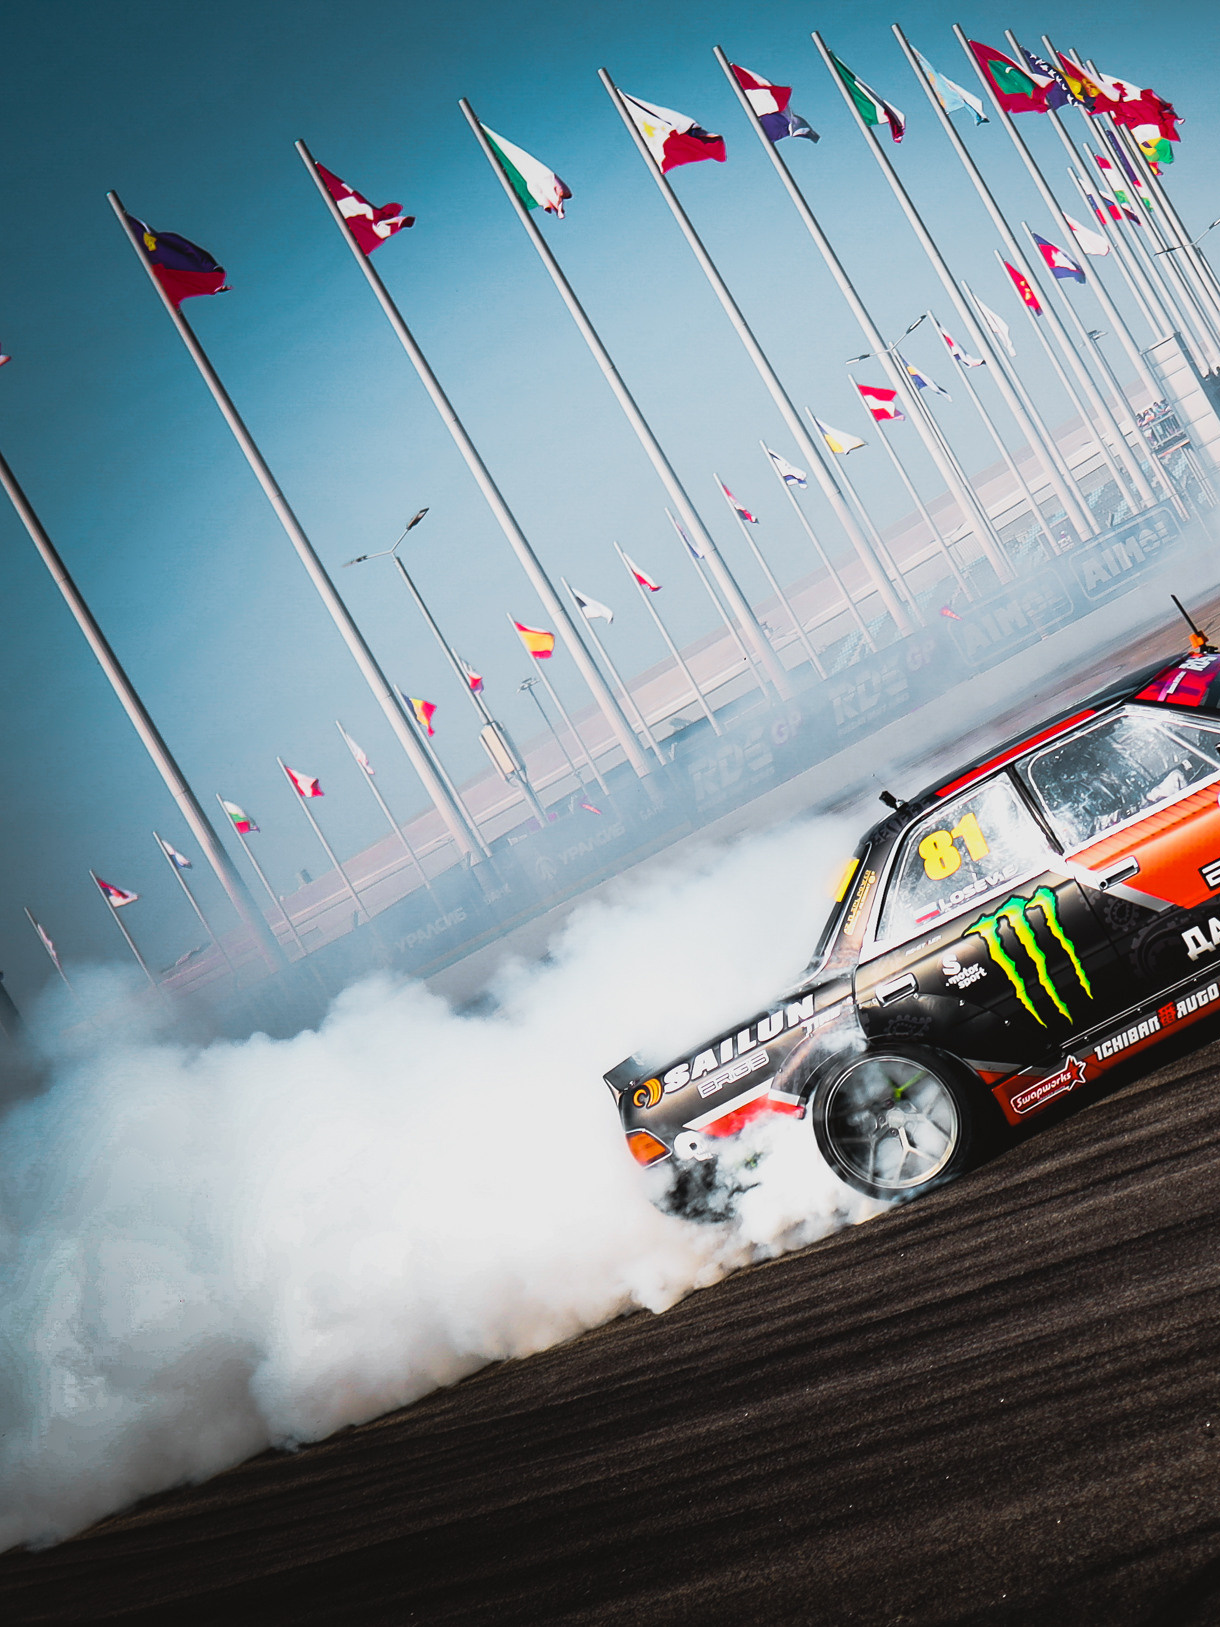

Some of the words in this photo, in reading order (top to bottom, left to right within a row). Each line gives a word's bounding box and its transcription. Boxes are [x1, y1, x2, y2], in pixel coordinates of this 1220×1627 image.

[918, 812, 991, 881] 81
[958, 967, 988, 990] sport
[1176, 982, 1220, 1019] AUTO
[663, 993, 815, 1095] SAILUN
[1016, 1072, 1072, 1109] Swapworks
